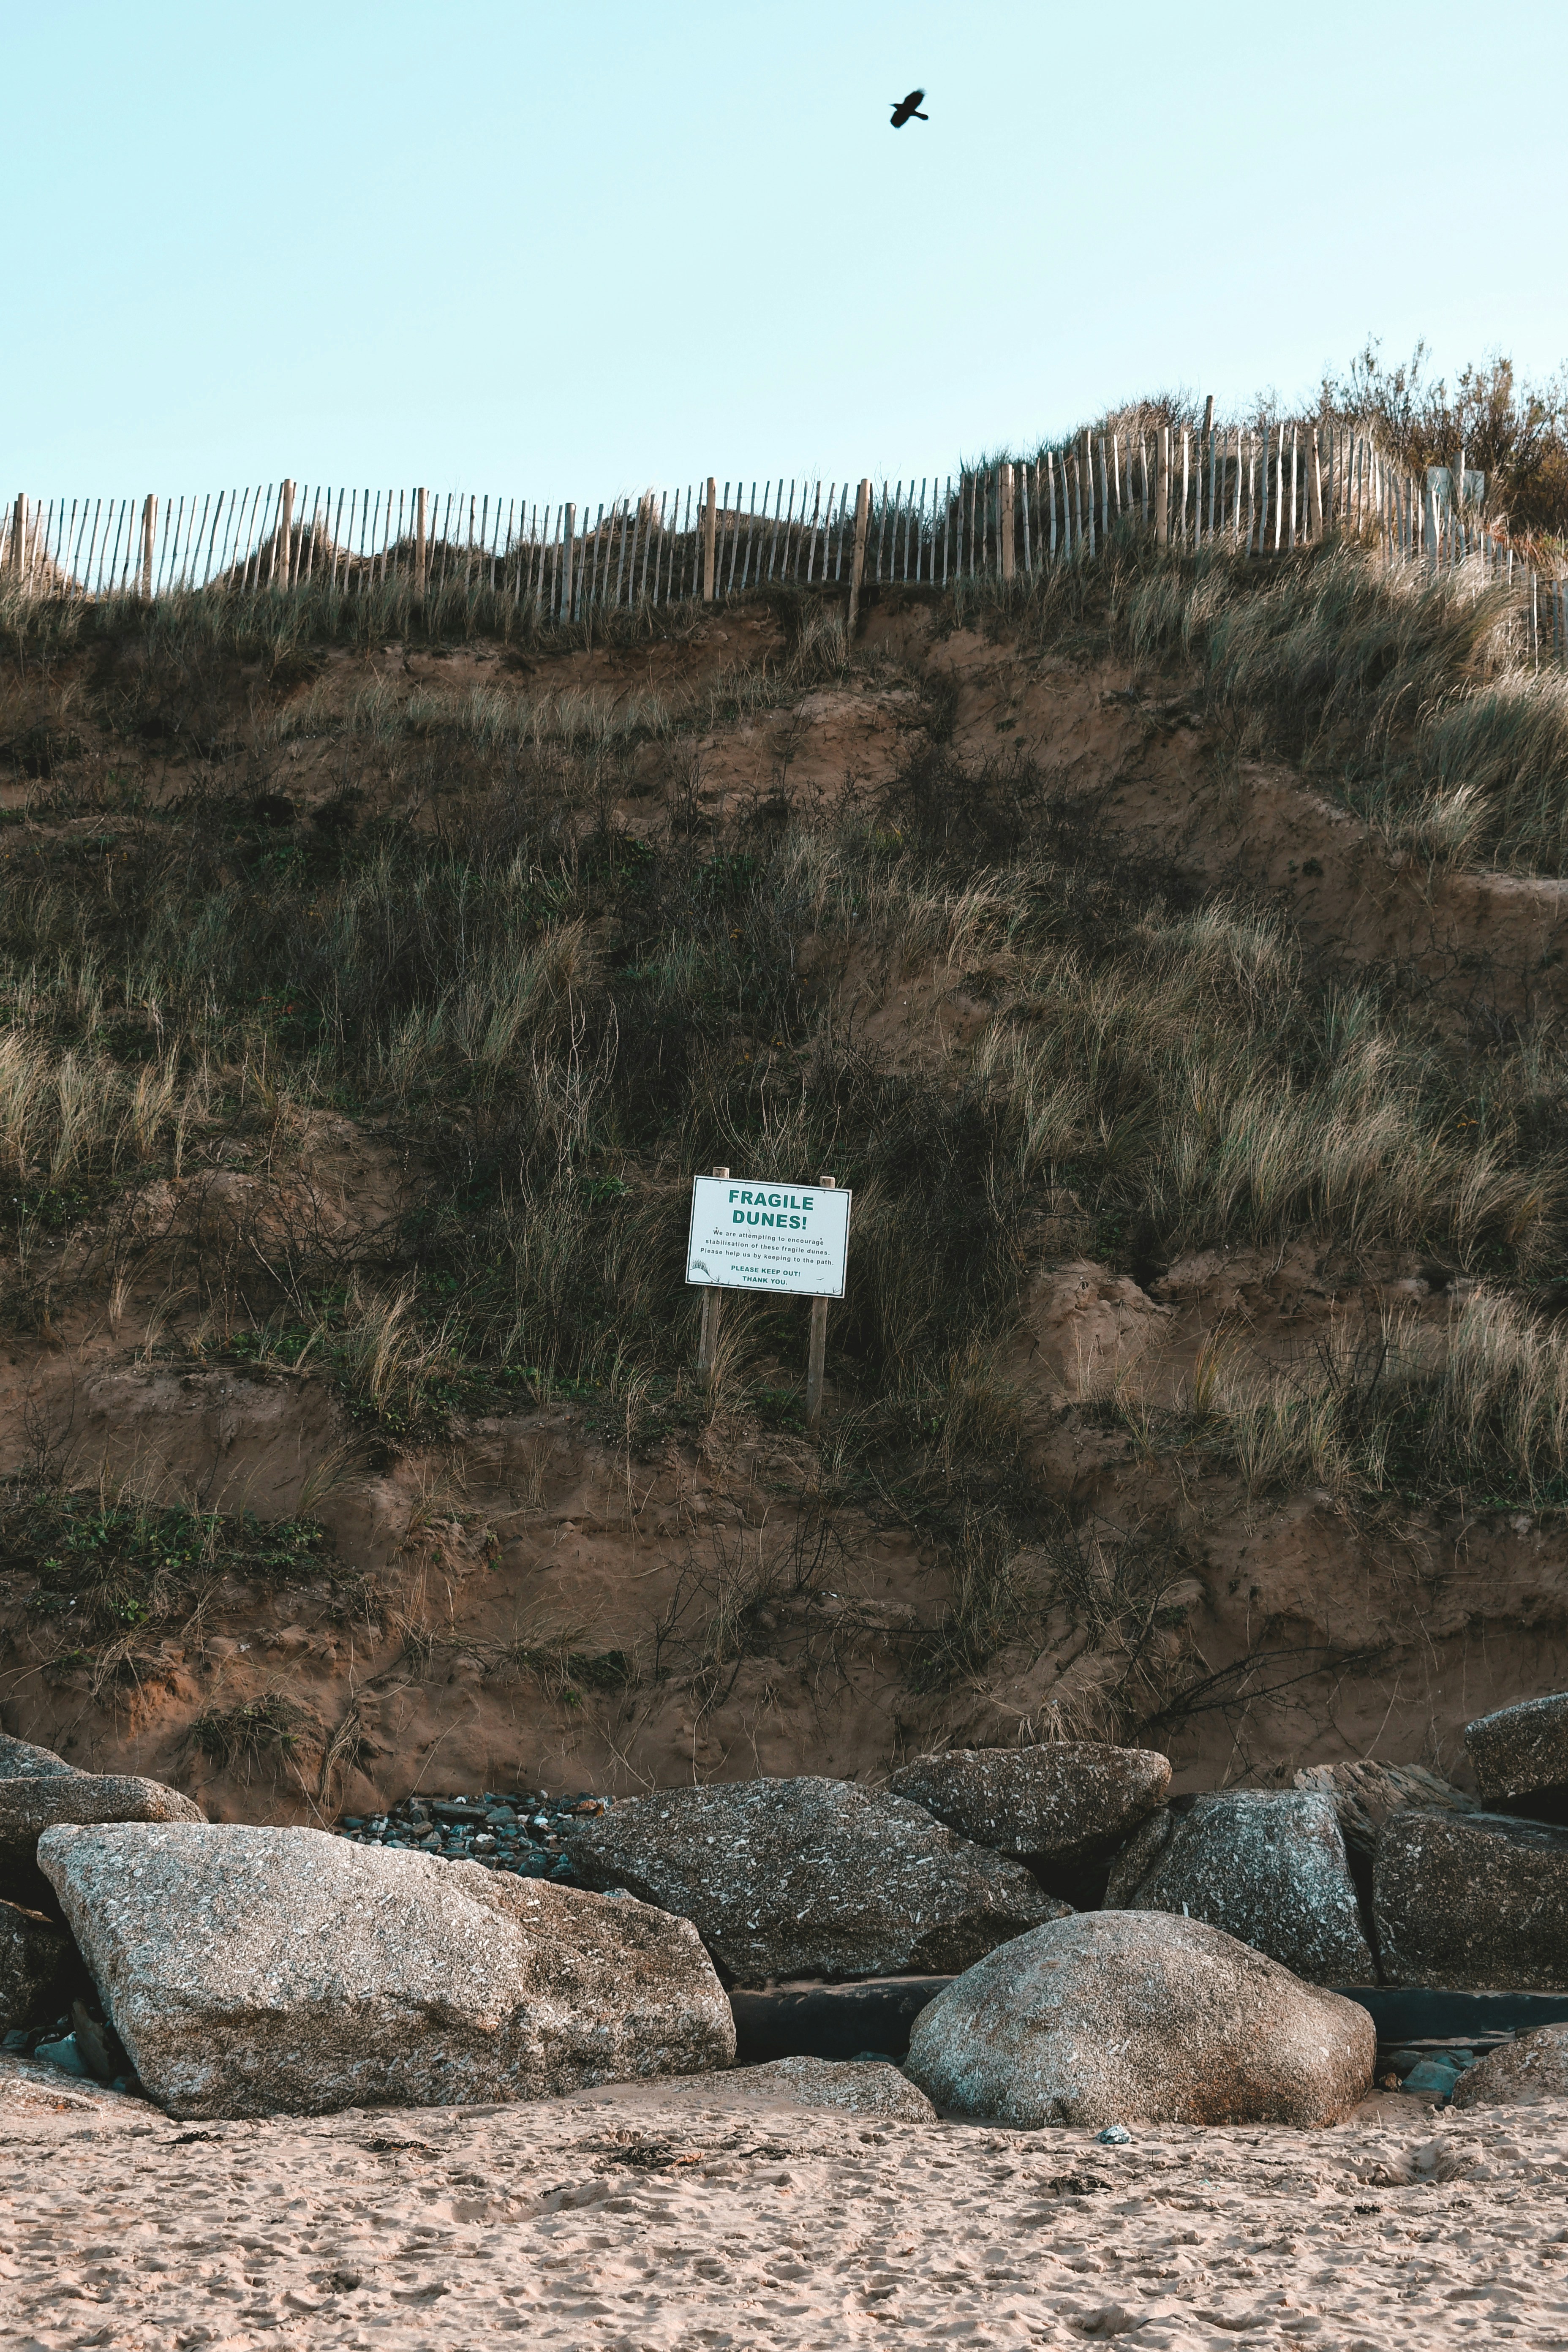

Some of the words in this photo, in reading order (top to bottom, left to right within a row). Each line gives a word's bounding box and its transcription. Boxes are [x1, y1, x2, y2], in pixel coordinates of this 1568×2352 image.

[729, 1190, 814, 1211] FRAGILE
[732, 1210, 807, 1230] DUNES!
[705, 1239, 749, 1248] stabilisation
[738, 1233, 776, 1242] attempting
[787, 1237, 824, 1246] encourage
[764, 1254, 791, 1263] keeping
[731, 1265, 759, 1273] PLEASE
